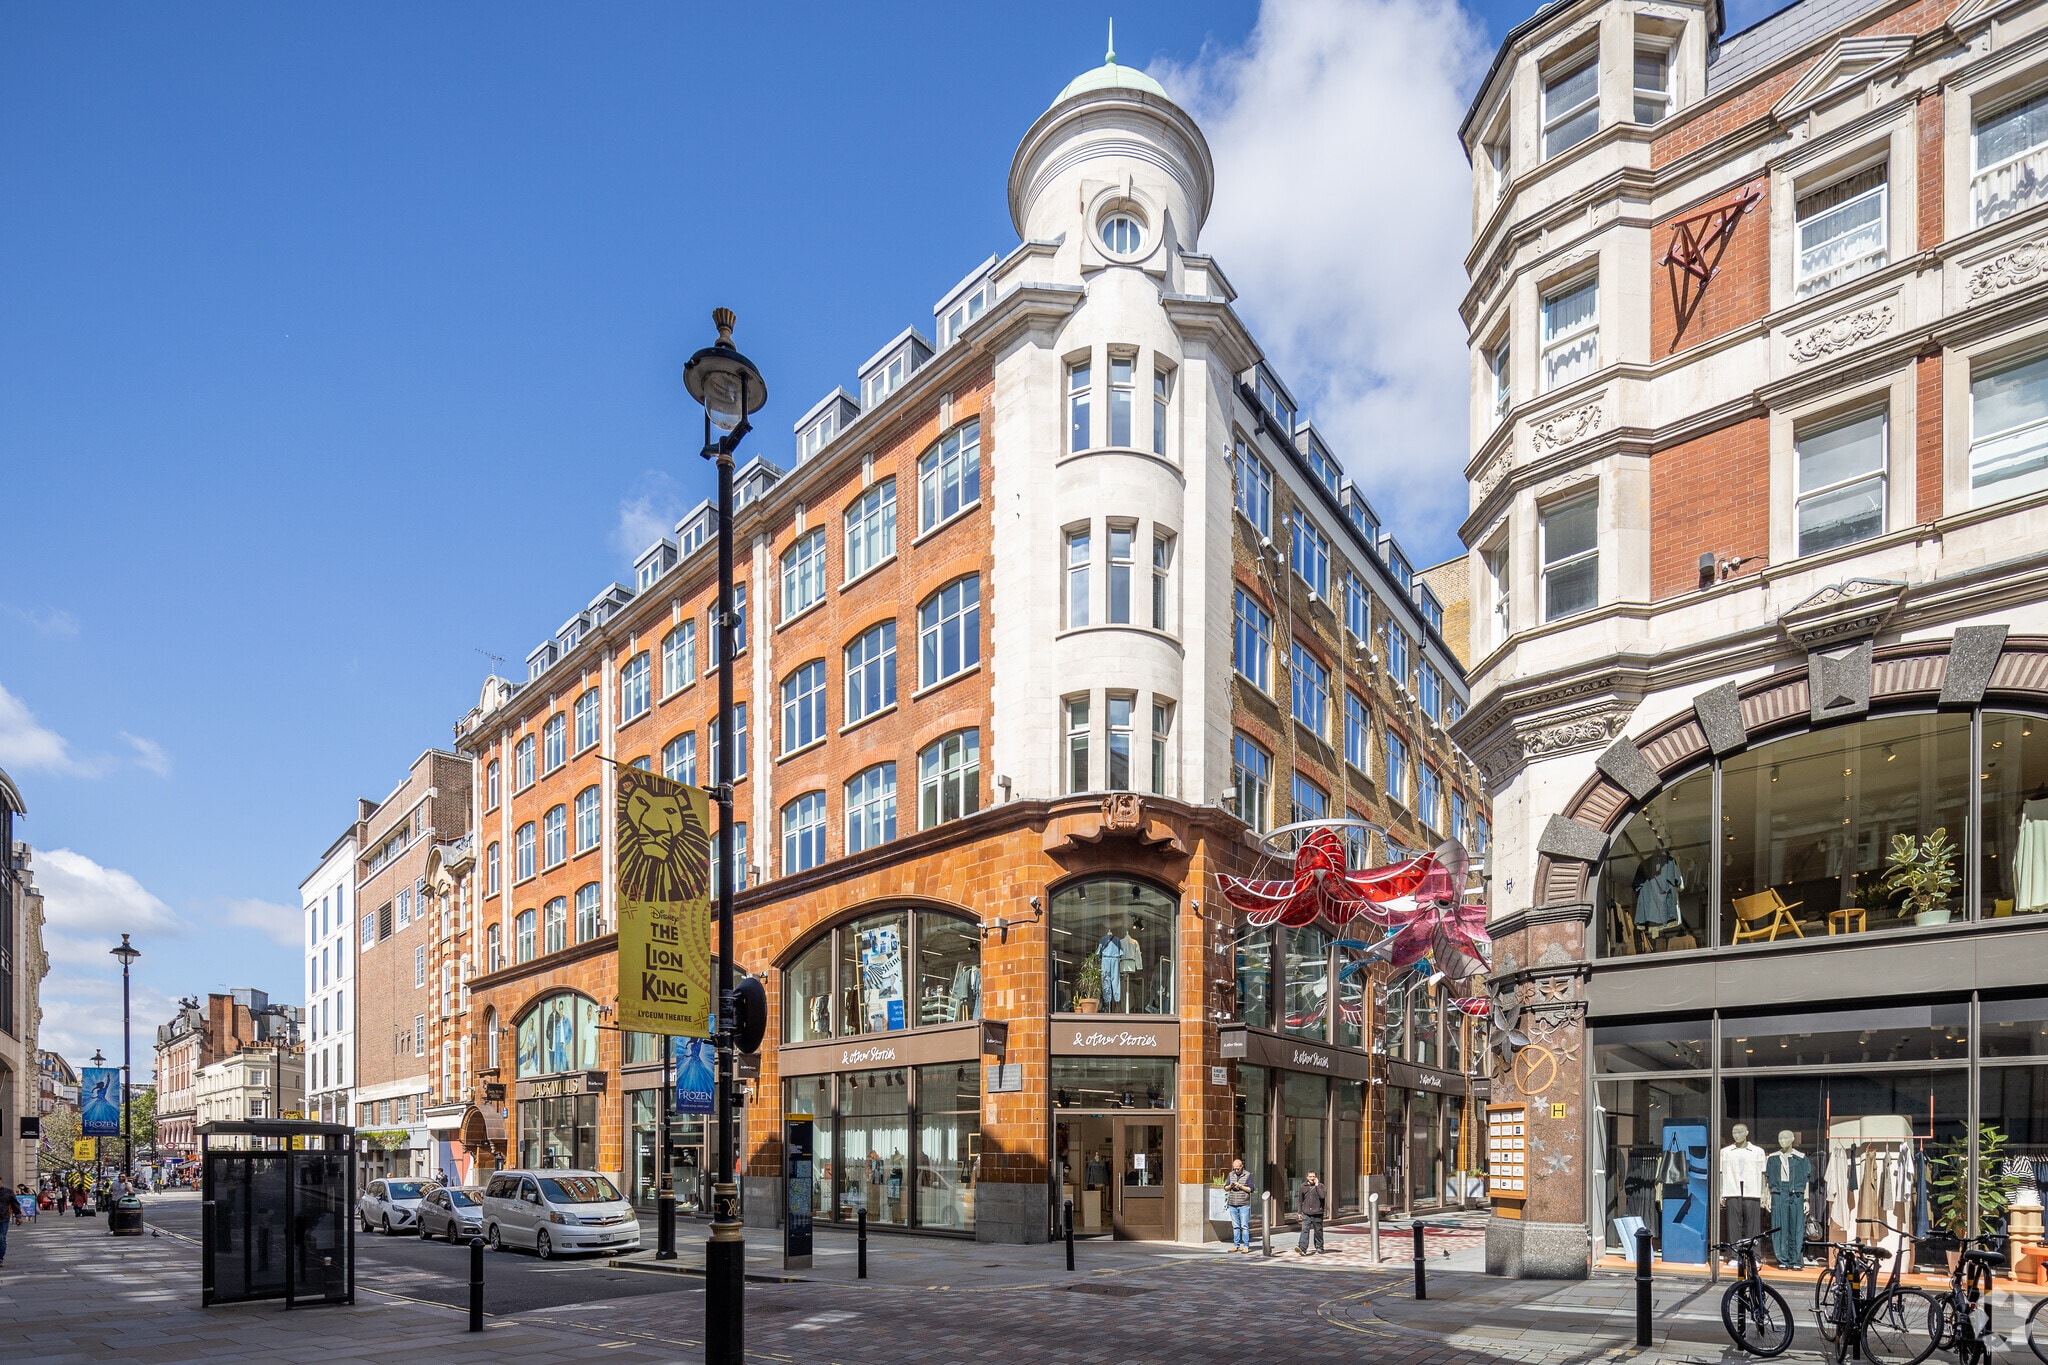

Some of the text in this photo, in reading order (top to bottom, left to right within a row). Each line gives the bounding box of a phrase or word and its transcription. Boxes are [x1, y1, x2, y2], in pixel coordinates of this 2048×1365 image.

[651, 922, 678, 941] THE
[645, 943, 683, 970] LION
[642, 972, 687, 1002] KING
[638, 1010, 692, 1022] LYCEUM THEATRE
[1073, 1032, 1157, 1047] & other Stories
[841, 1046, 896, 1064] & other Stories
[531, 1078, 579, 1098] JACK WILLS
[678, 1088, 713, 1102] FROZEN
[84, 1119, 118, 1129] FROZEN
